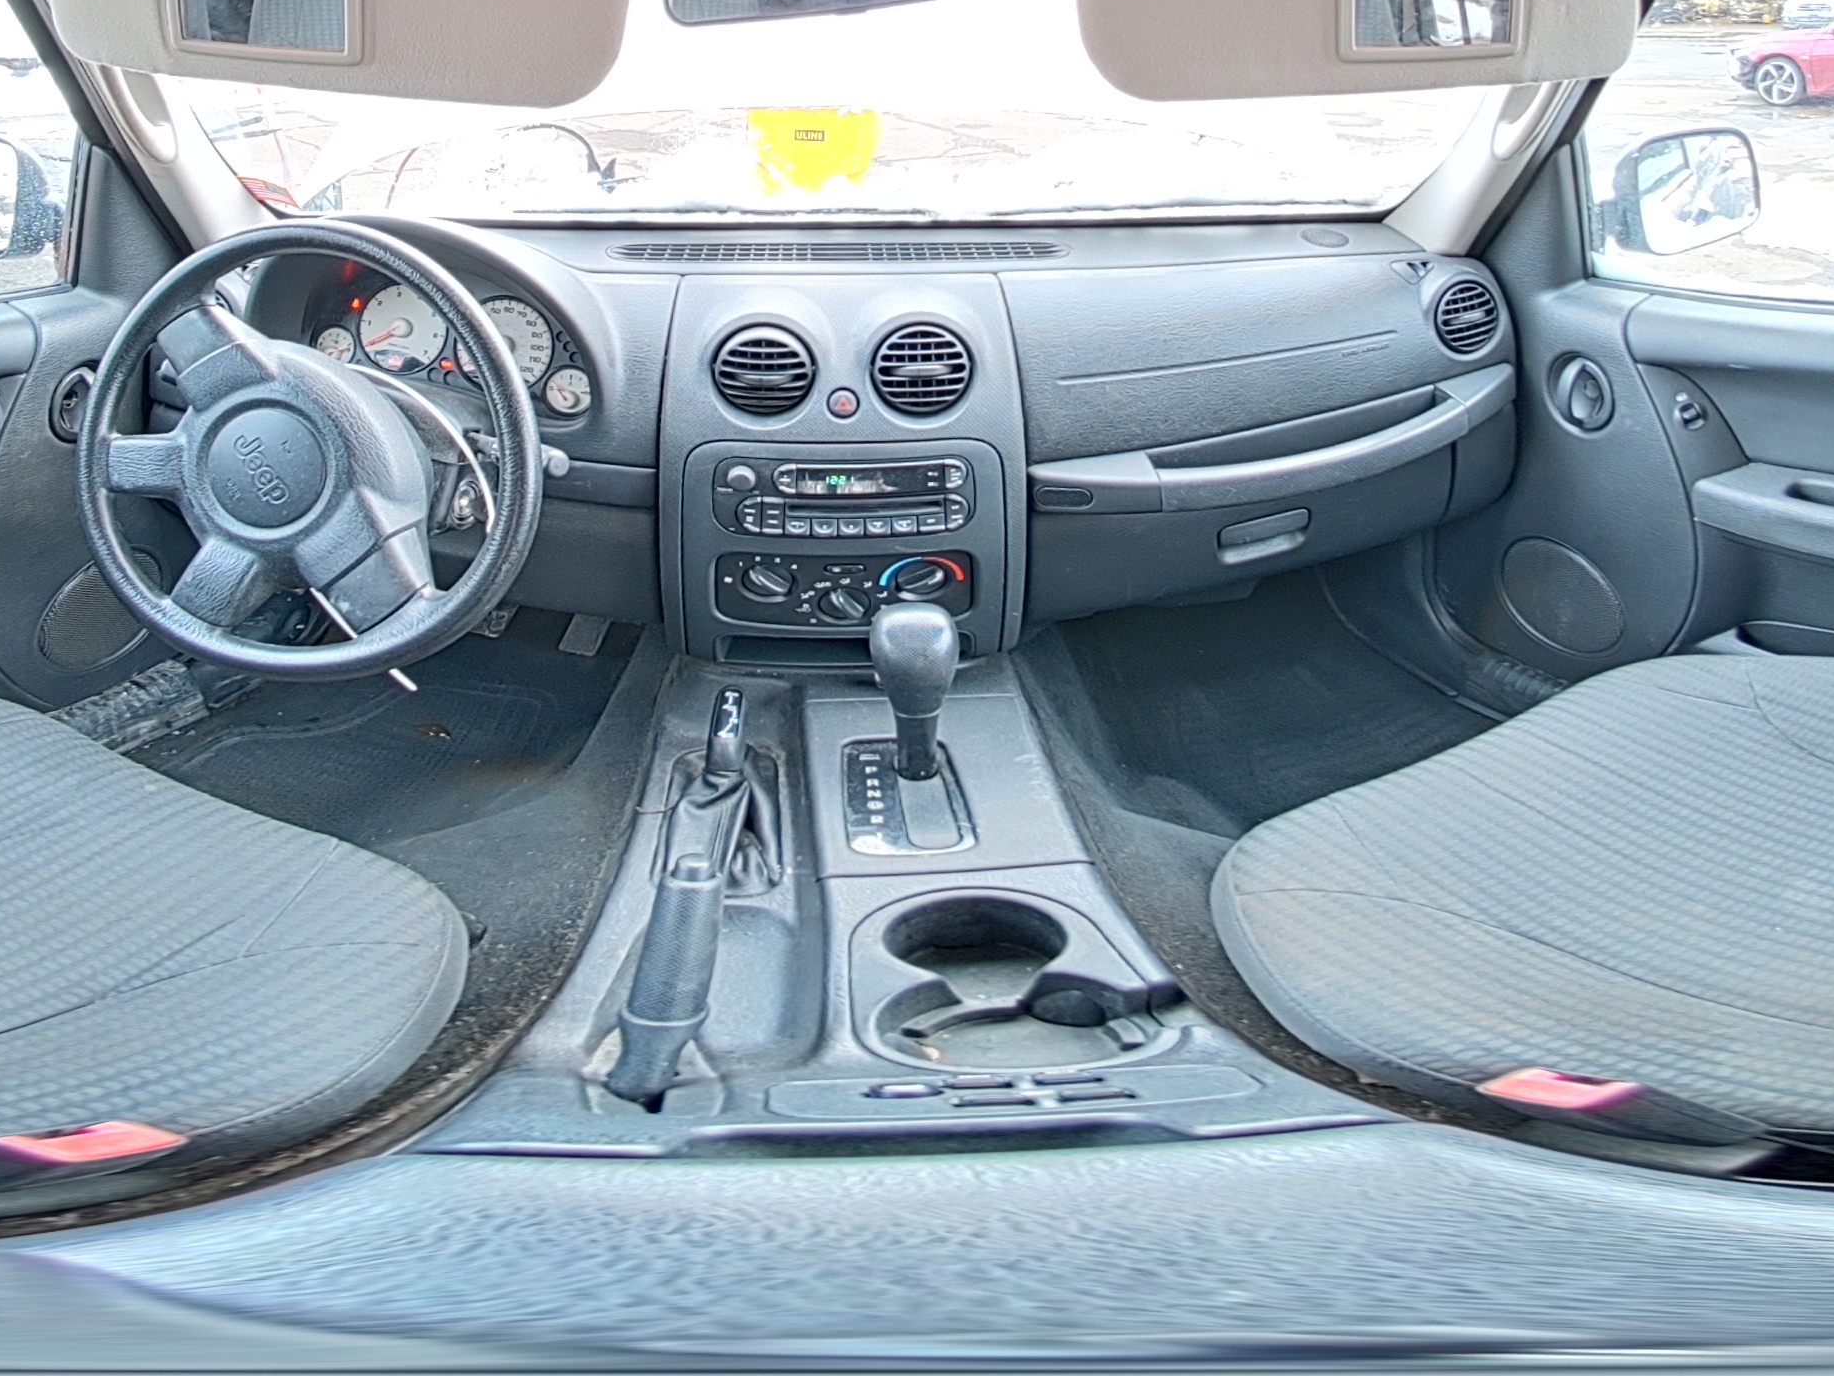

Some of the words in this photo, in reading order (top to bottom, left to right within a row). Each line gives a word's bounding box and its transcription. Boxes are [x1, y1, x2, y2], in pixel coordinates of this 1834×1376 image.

[233, 434, 290, 505] Jeep
[865, 766, 878, 775] P
[867, 789, 881, 798] N
